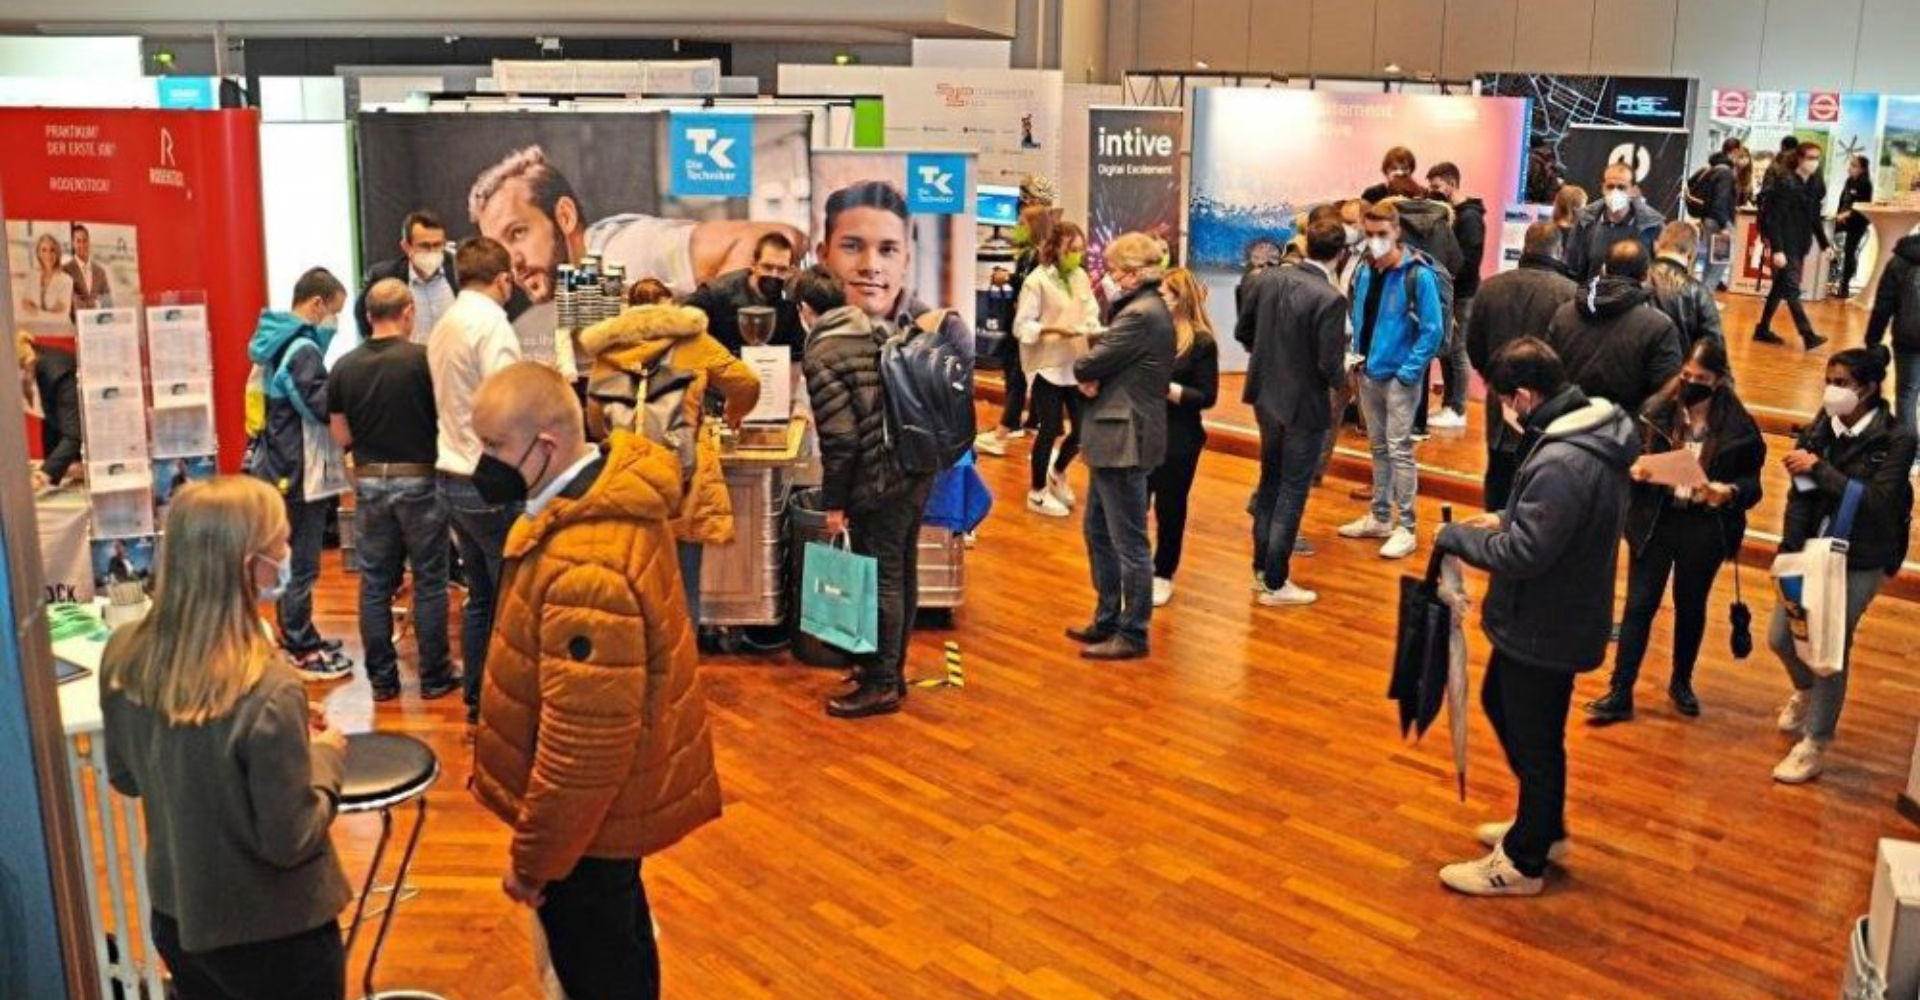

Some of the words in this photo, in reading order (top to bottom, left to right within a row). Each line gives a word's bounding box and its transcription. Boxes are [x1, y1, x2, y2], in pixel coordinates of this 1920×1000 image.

[47, 141, 66, 156] DER
[685, 128, 736, 168] TK
[1098, 126, 1173, 156] intive
[686, 170, 736, 181] Techniker
[918, 166, 953, 195] TK
[1097, 163, 1124, 177] Digital
